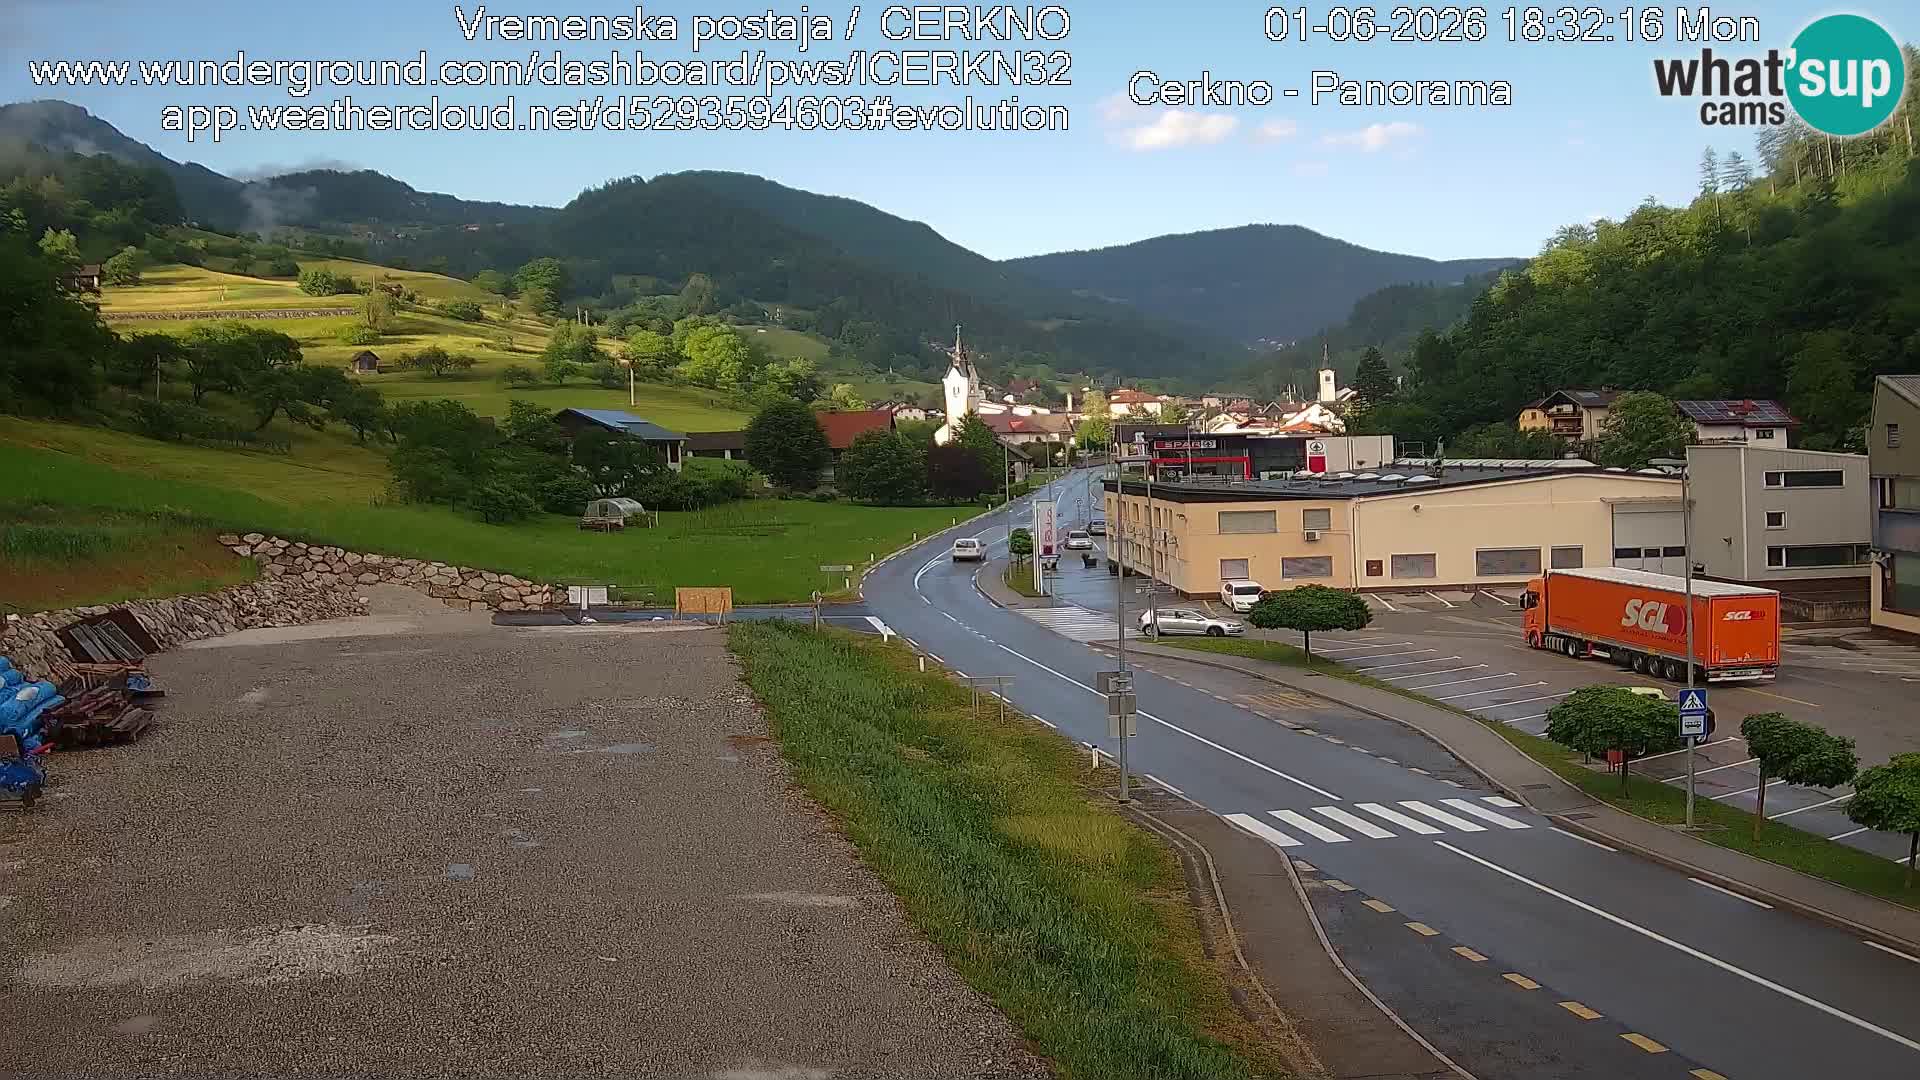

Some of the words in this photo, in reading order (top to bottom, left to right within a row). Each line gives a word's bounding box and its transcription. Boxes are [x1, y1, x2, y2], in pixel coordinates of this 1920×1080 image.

[1165, 441, 1201, 449] SPAR
[1621, 598, 1669, 634] SGL
[1722, 610, 1752, 621] SGL
